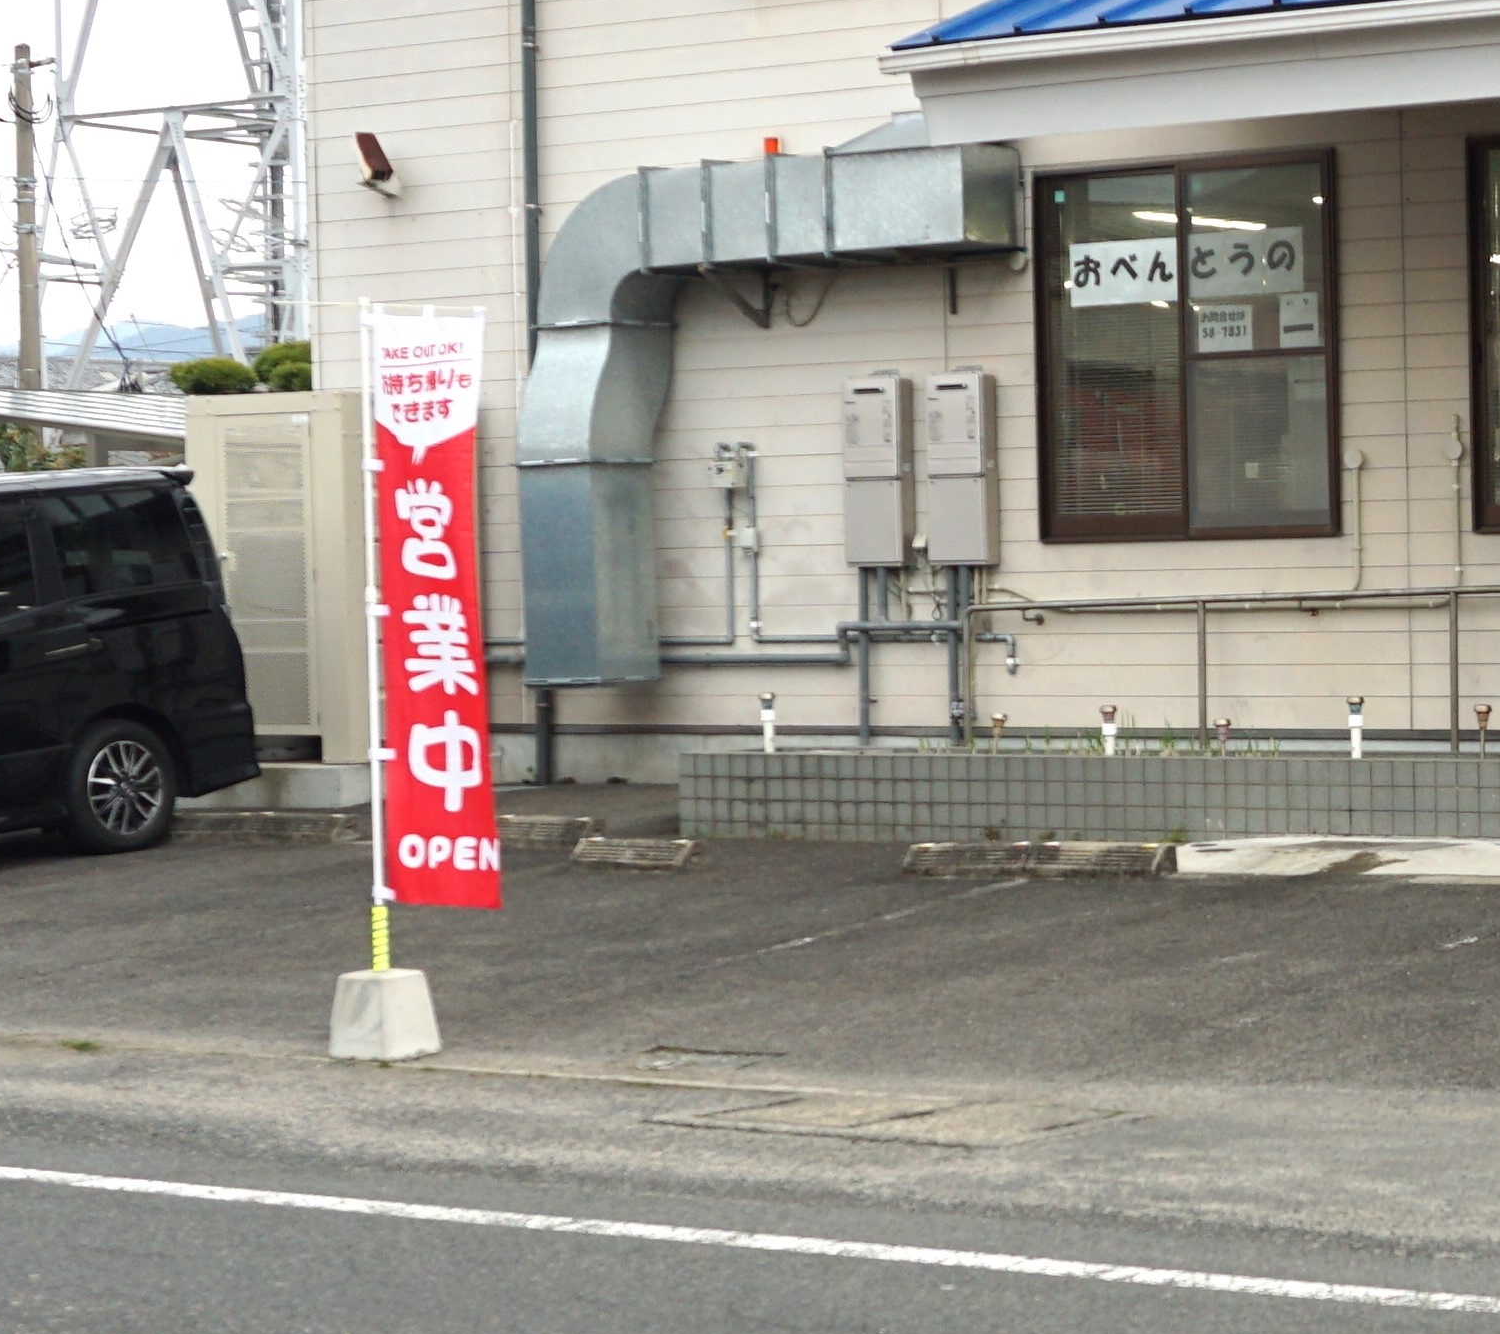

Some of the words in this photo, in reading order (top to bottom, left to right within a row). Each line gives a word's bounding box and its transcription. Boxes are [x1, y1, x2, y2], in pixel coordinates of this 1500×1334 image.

[394, 478, 484, 813] 営業中
[398, 834, 500, 872] OPEN
